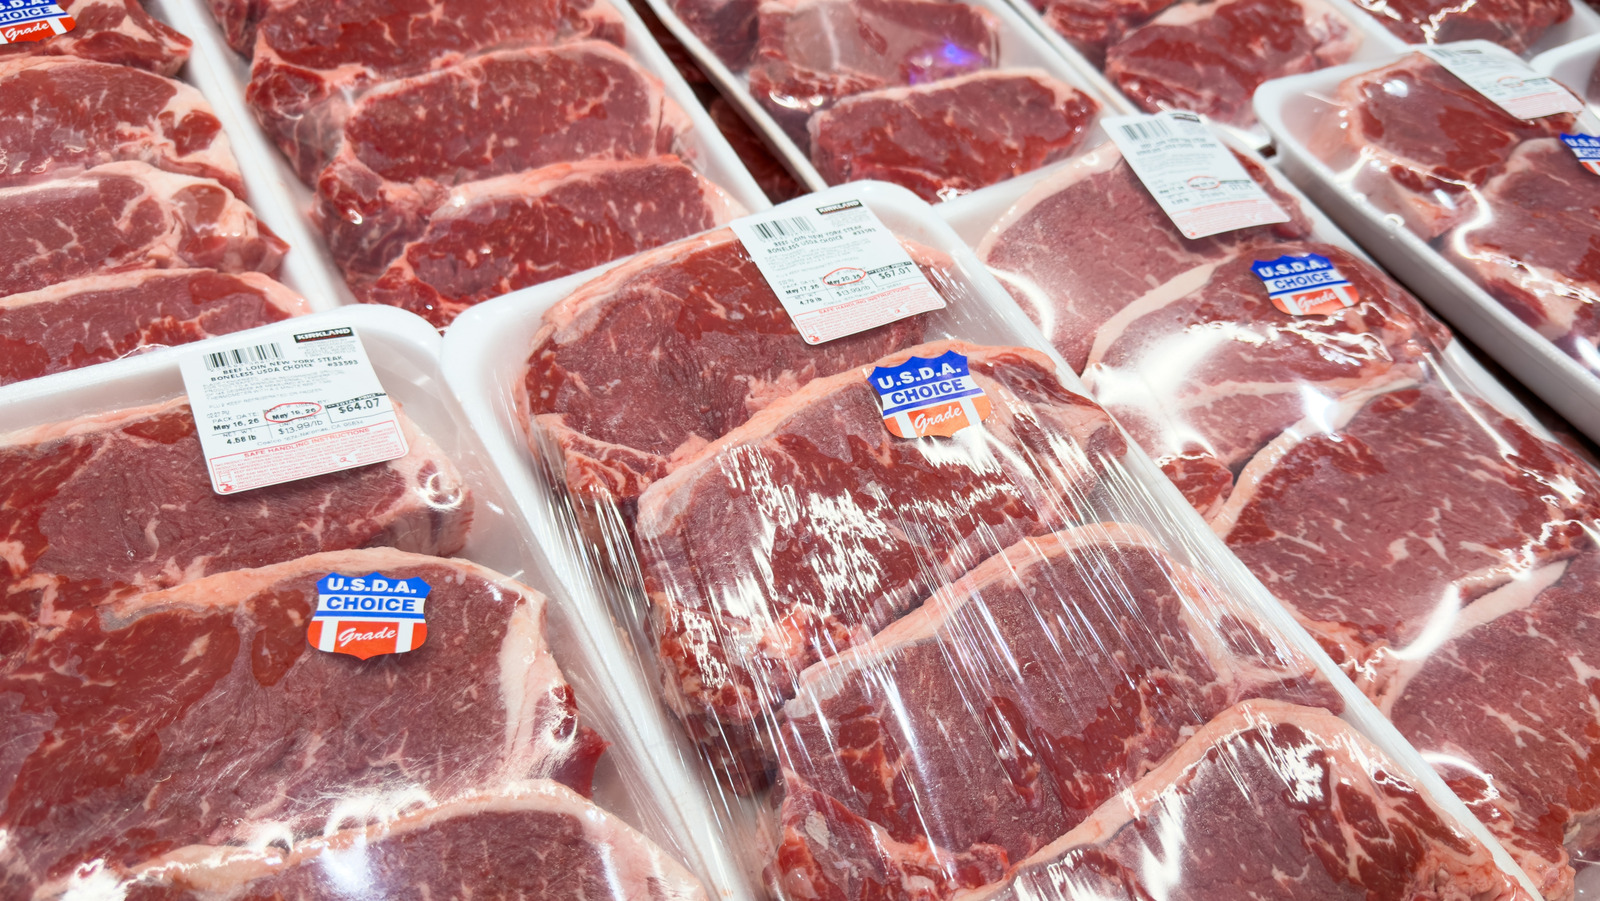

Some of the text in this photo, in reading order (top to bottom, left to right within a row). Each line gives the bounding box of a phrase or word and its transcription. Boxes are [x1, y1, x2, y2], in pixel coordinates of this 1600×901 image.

[5, 22, 50, 41] Grade
[818, 200, 861, 213] KIRKLAND
[878, 266, 911, 280] $67.01
[1258, 260, 1329, 278] U.S.D.A.
[1274, 271, 1334, 290] CHOICE
[1298, 290, 1337, 313] Grade
[296, 328, 350, 340] KIRKLAND
[211, 359, 359, 381] BONELESS USDA CHOICE #33593
[223, 367, 243, 375] BEEF
[318, 355, 343, 363] STEAK
[877, 362, 962, 390] U.S.D.A.
[891, 378, 966, 405] CHOICE
[338, 398, 379, 414] $64.07
[272, 412, 288, 421] May
[914, 405, 963, 434] Grade
[213, 423, 231, 431] May
[278, 420, 323, 435] $13.99/lb
[226, 436, 247, 445] 4.58
[244, 427, 370, 458] SAFE HANDLING INSTRUCTIONS
[327, 577, 417, 594] U.S.D.A.
[326, 596, 416, 611] CHOICE
[338, 626, 397, 648] Grade
